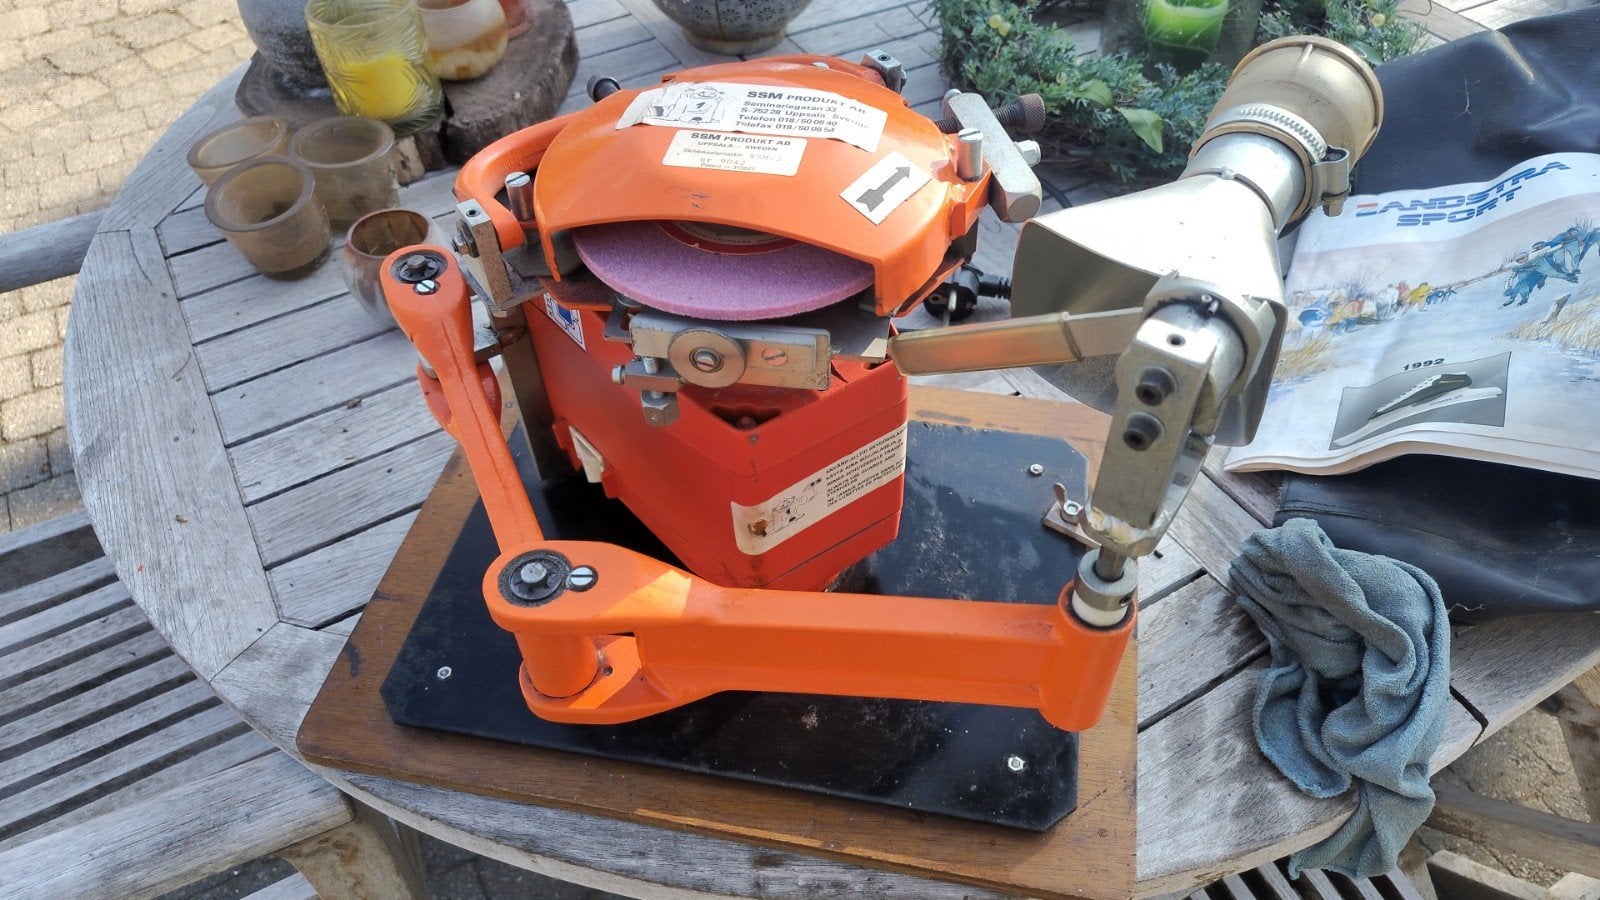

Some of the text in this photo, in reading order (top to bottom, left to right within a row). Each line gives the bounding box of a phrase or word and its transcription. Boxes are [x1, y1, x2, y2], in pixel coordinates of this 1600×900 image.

[747, 91, 784, 99] SSM
[786, 94, 845, 106] PRODUKT
[743, 100, 823, 112] Seminariegatan
[735, 121, 772, 129] Telefax
[738, 114, 776, 123] Telefon
[690, 132, 721, 141] SSM
[723, 136, 775, 145] PRODUKT
[698, 141, 733, 149] UPPSALA
[1356, 161, 1571, 217] ZANDSTRA
[1396, 185, 1522, 227] SPORT
[1403, 358, 1445, 371] 1992
